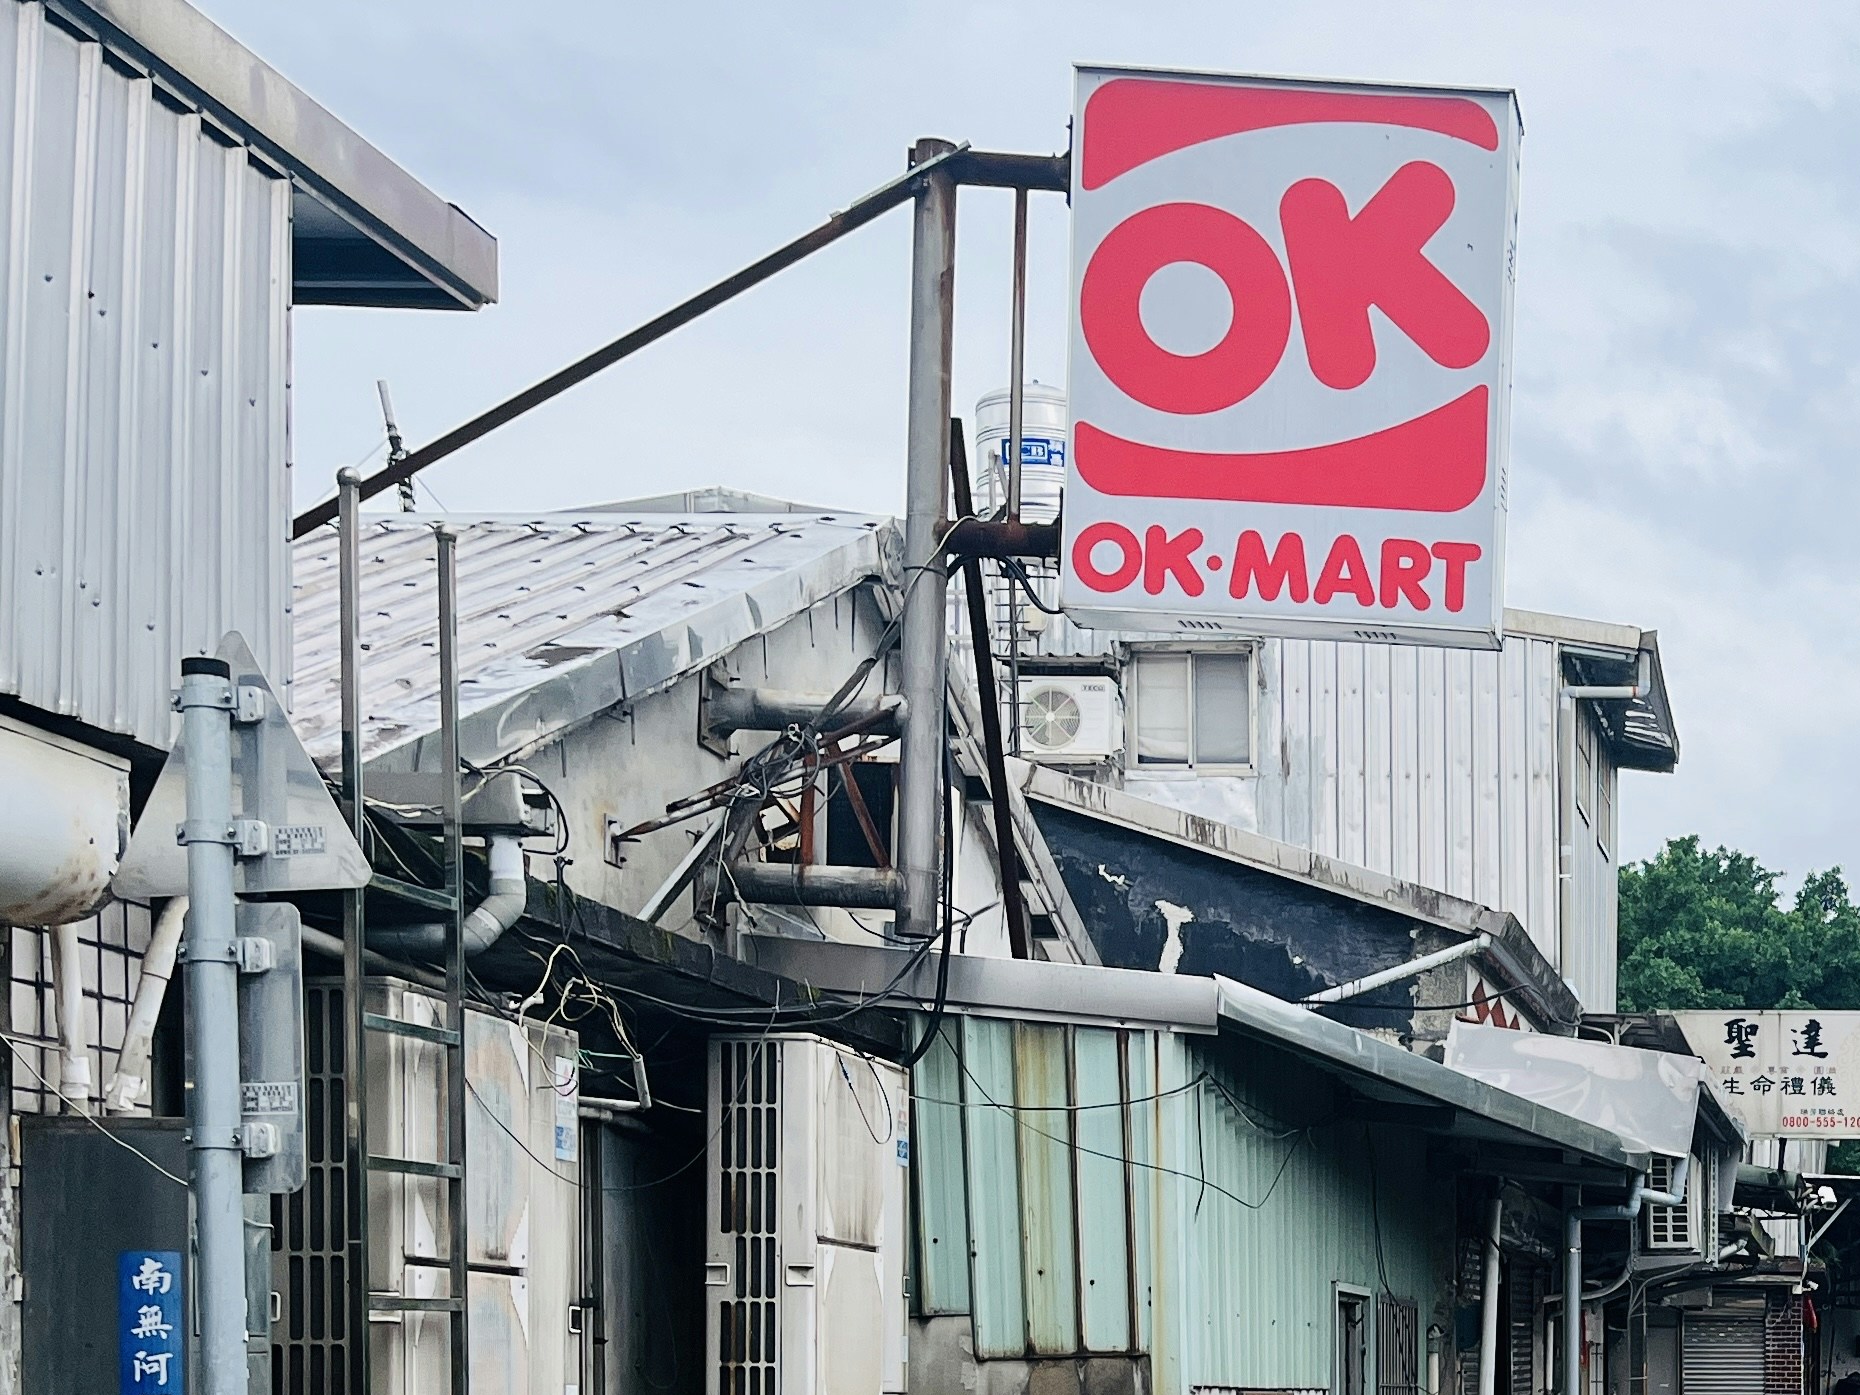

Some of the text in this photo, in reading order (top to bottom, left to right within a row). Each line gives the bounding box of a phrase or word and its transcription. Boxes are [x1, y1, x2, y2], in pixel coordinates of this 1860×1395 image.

[1080, 160, 1490, 415] OK
[1723, 1017, 1829, 1059] 聖達
[1722, 1074, 1838, 1096] 生命禮儀
